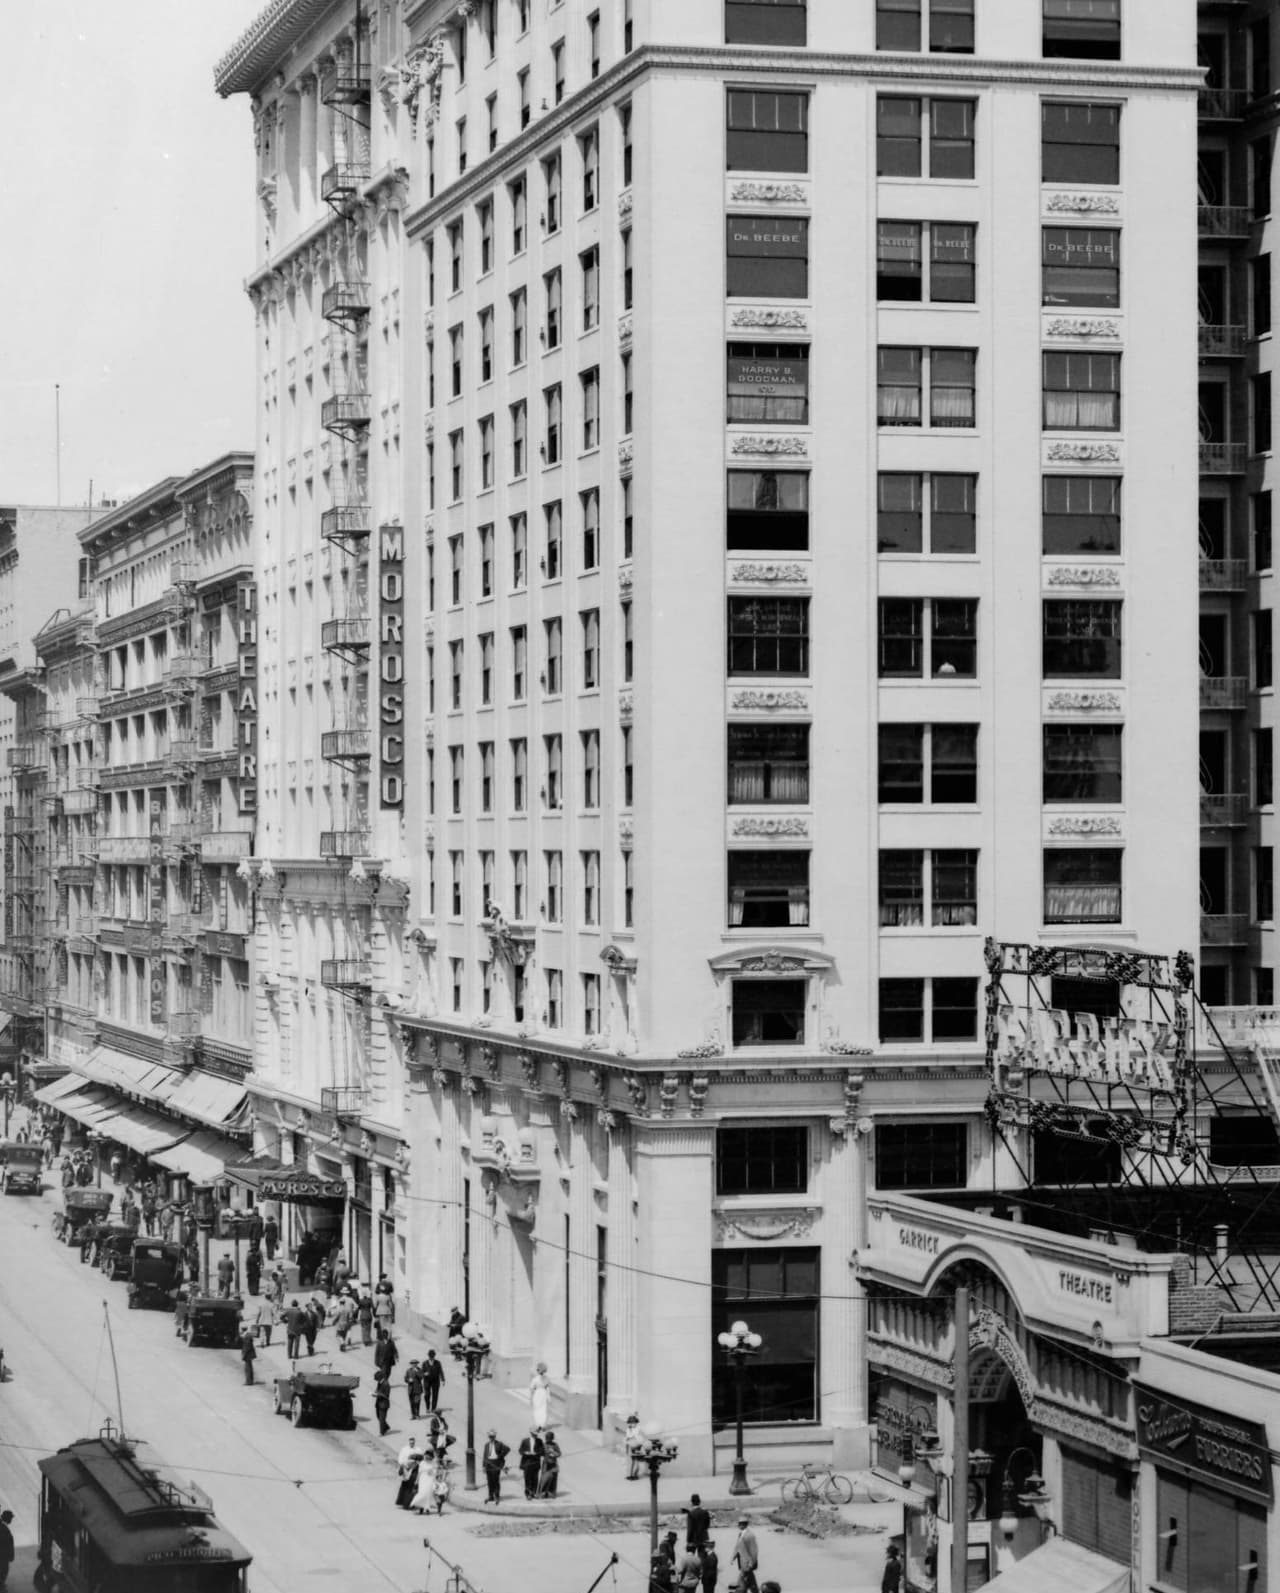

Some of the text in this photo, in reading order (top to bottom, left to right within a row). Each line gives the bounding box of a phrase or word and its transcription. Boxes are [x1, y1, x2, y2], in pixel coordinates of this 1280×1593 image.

[239, 586, 257, 812] THEATRE
[381, 532, 403, 805] MOROSCO
[151, 799, 162, 1016] BARKER BROS
[263, 1181, 343, 1197] MOROSCO
[899, 1228, 940, 1255] GARRICK
[1057, 1270, 1113, 1304] THEATRE
